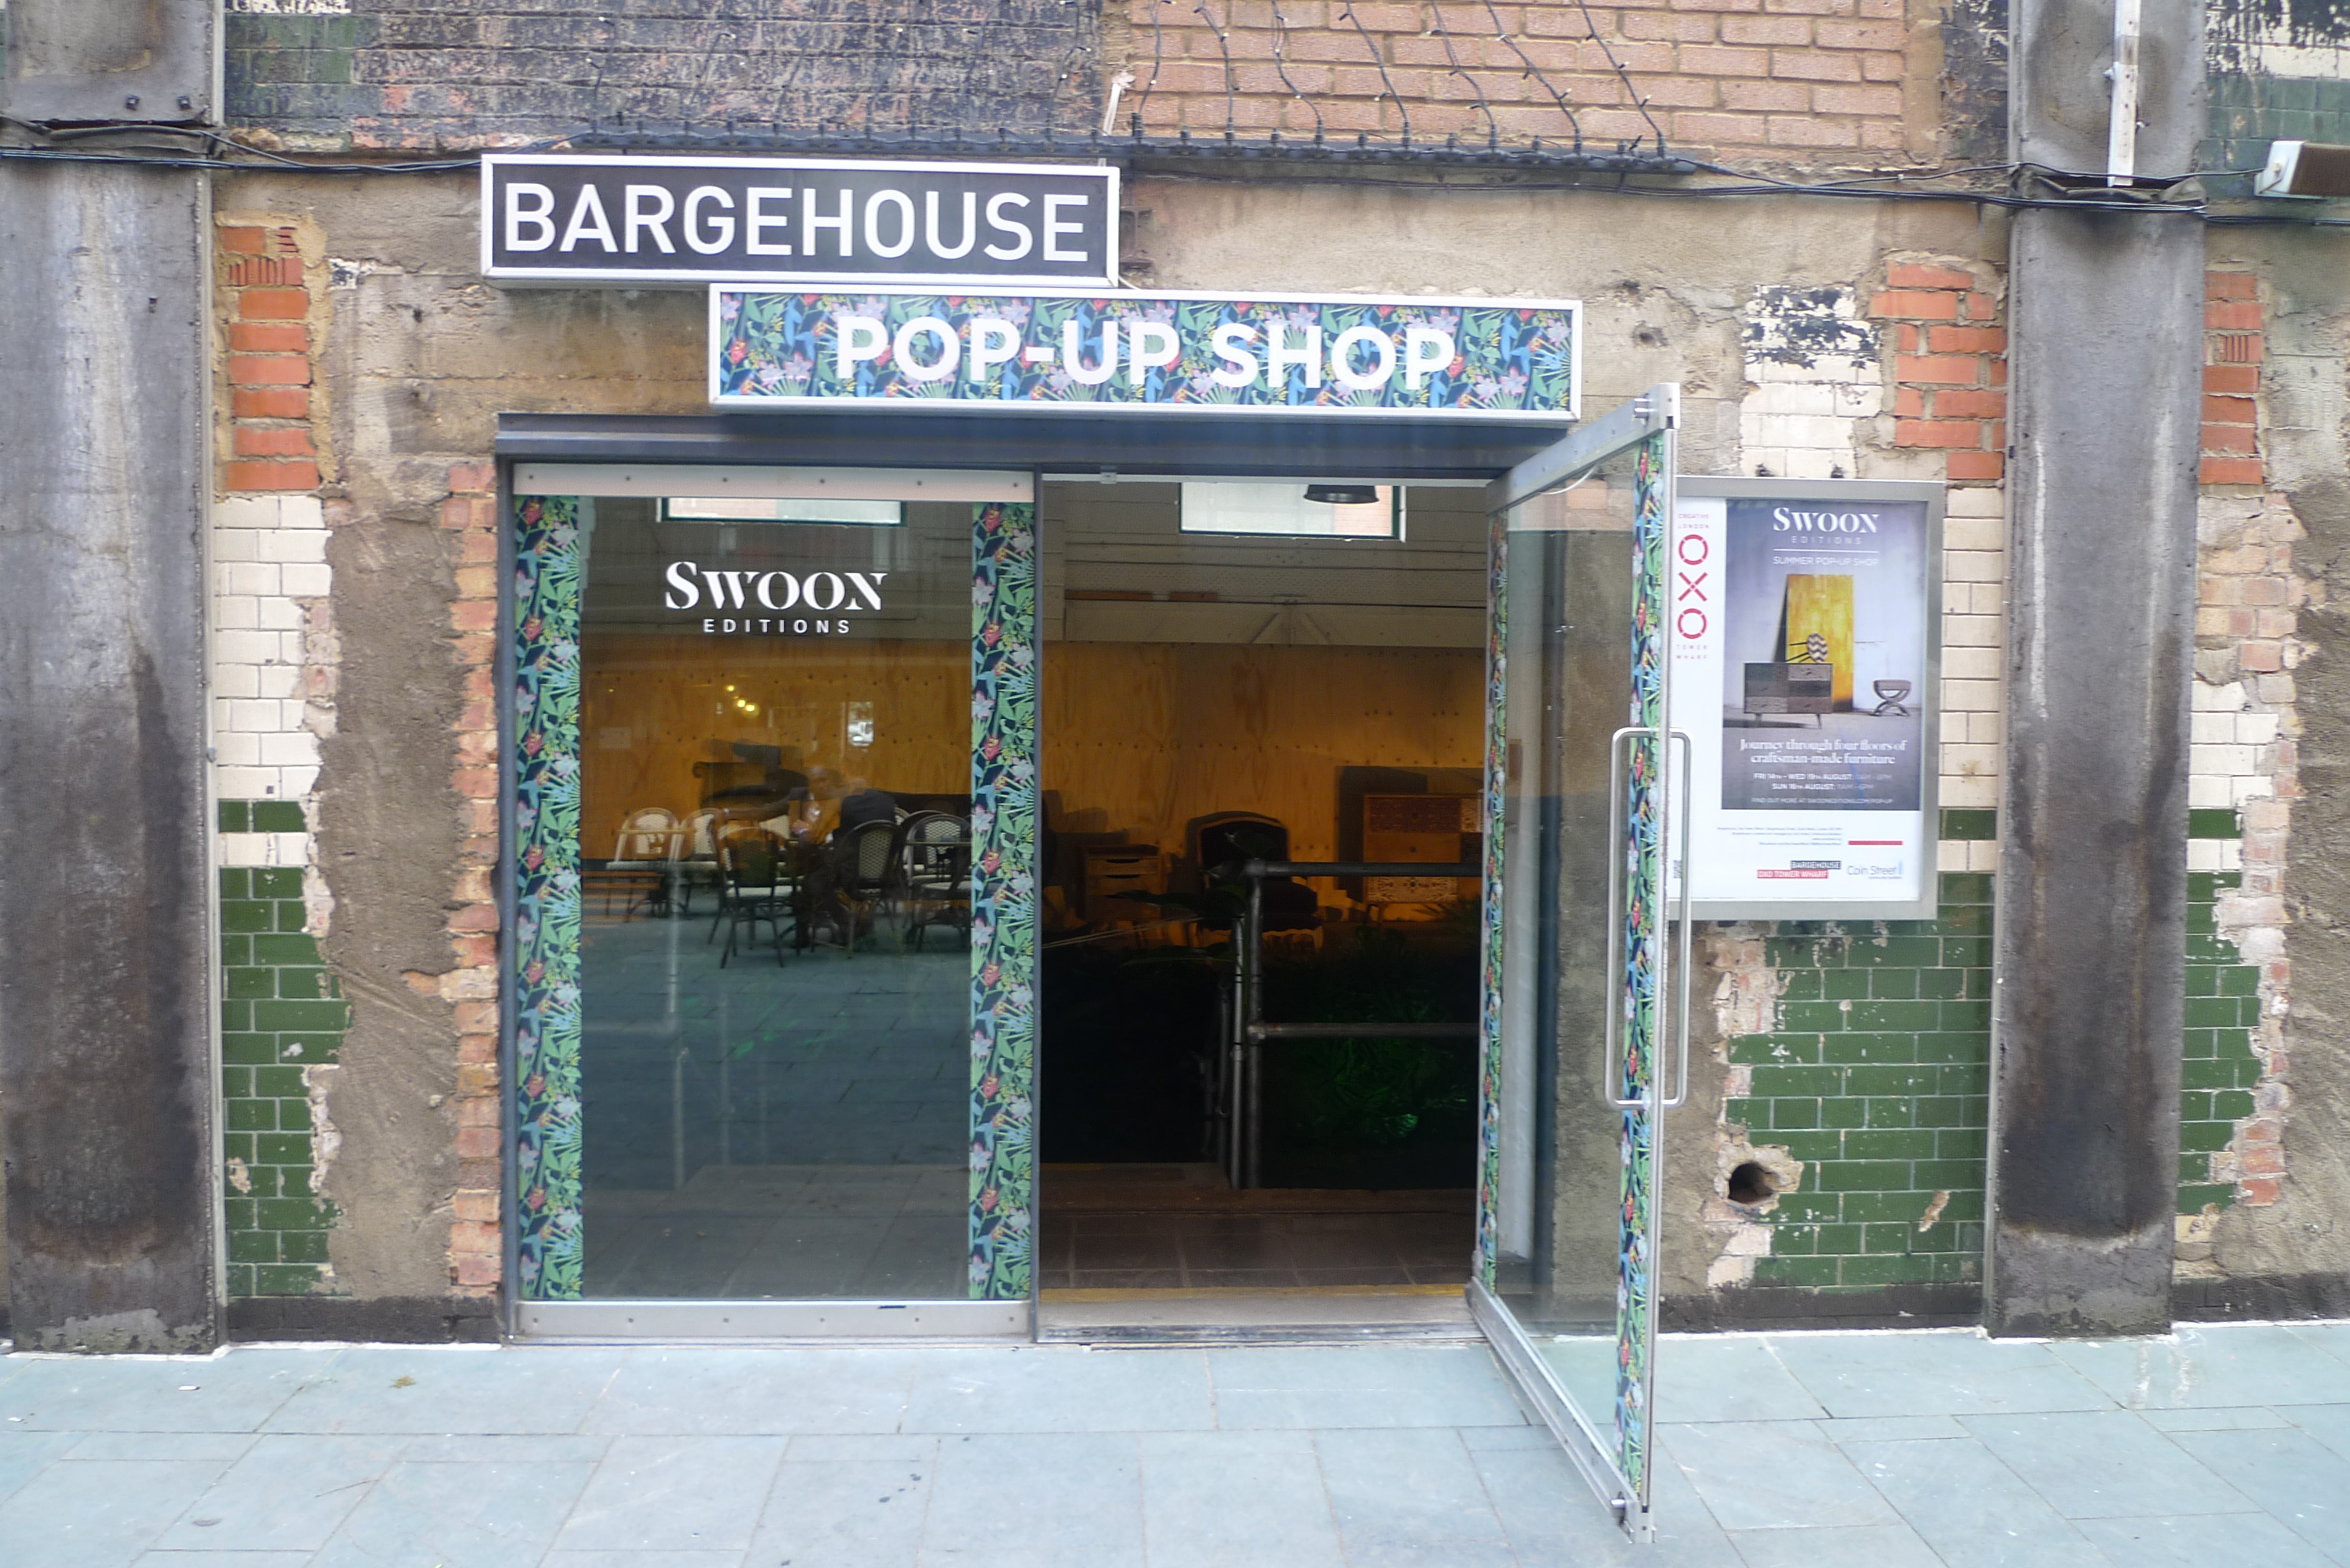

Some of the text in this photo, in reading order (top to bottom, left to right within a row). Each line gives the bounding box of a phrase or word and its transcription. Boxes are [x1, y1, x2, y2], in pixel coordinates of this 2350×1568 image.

[505, 182, 1088, 262] BARGEHOUSE
[836, 315, 1456, 390] POP-UP SHOP
[1773, 507, 1880, 533] SWOON
[1791, 536, 1861, 544] EDITIONS
[1772, 556, 1880, 566] SUMMER POP-UP SHOP
[666, 561, 888, 610] SWOON
[703, 619, 850, 633] EDITIONS
[1740, 739, 1908, 753] Journey through four floors of
[1751, 752, 1895, 763] craftsman-made furniture
[1847, 866, 1897, 875] Coin Street
